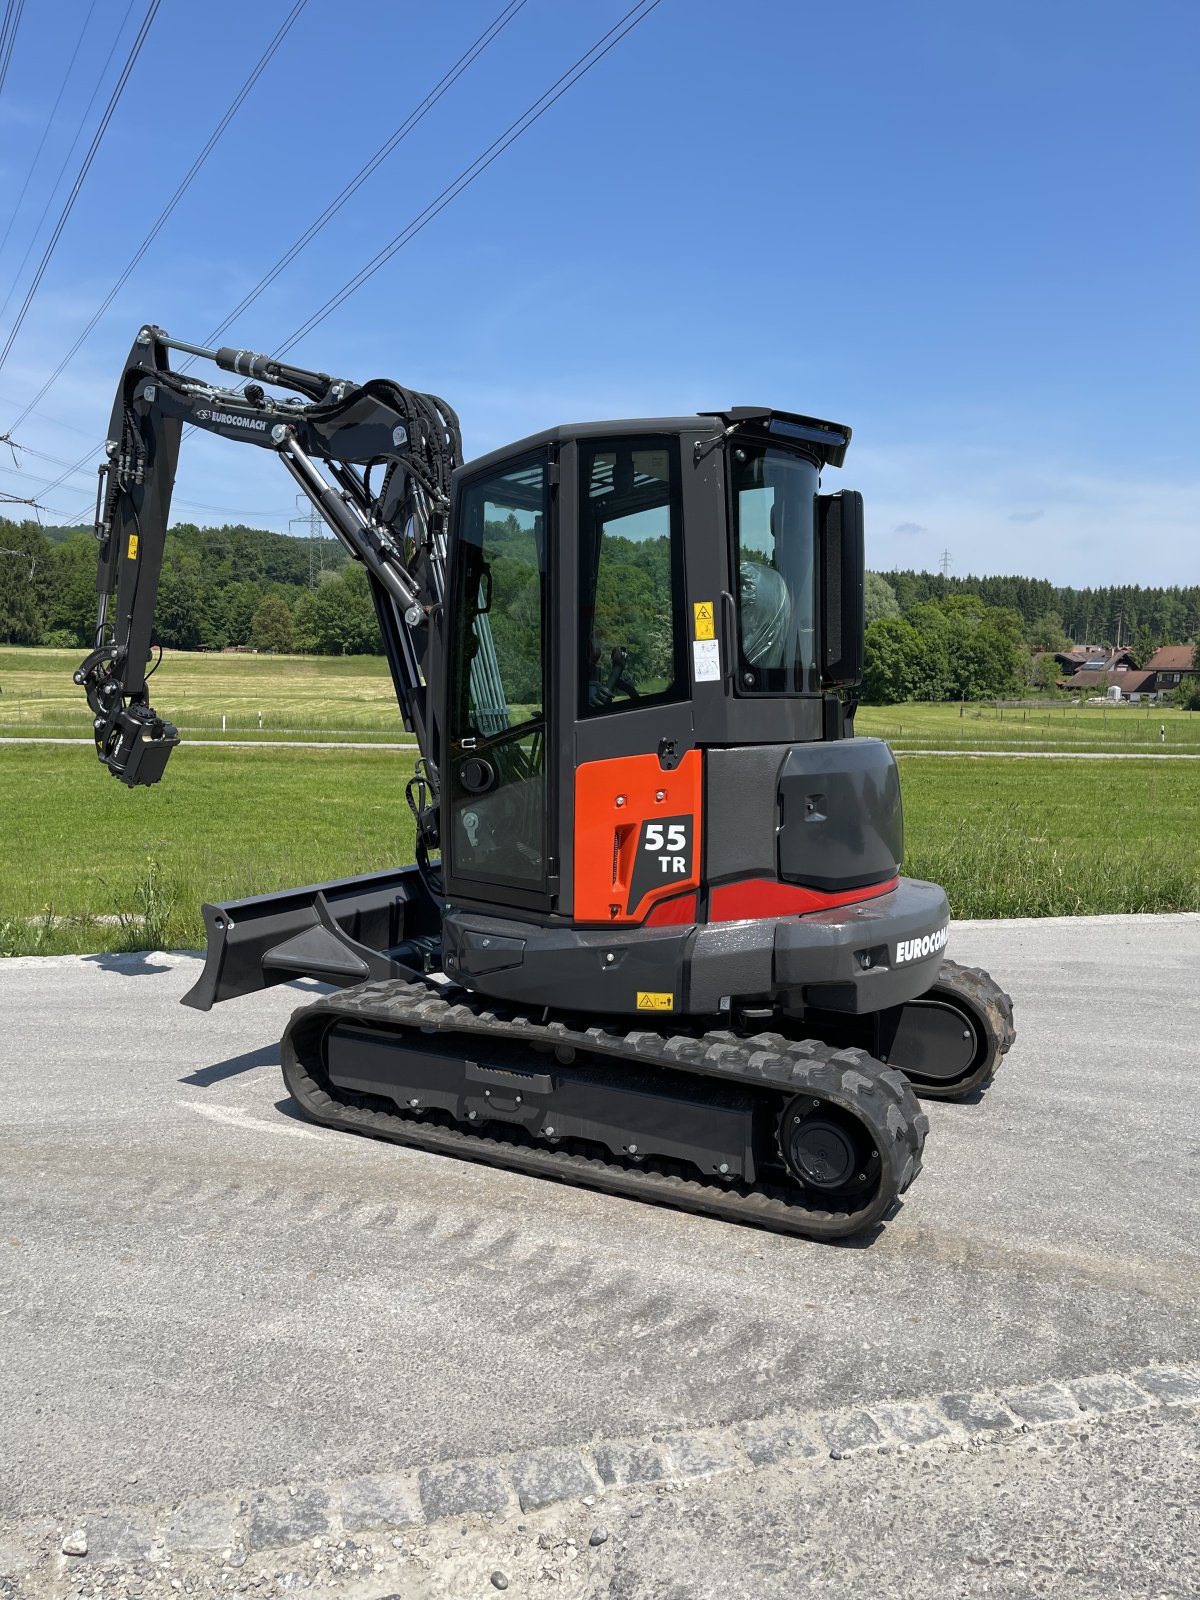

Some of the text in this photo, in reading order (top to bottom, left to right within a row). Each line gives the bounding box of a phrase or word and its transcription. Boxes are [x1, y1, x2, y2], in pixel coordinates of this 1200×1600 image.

[211, 411, 267, 431] EUROCOMACH
[644, 824, 687, 851] 55
[658, 856, 686, 873] TR
